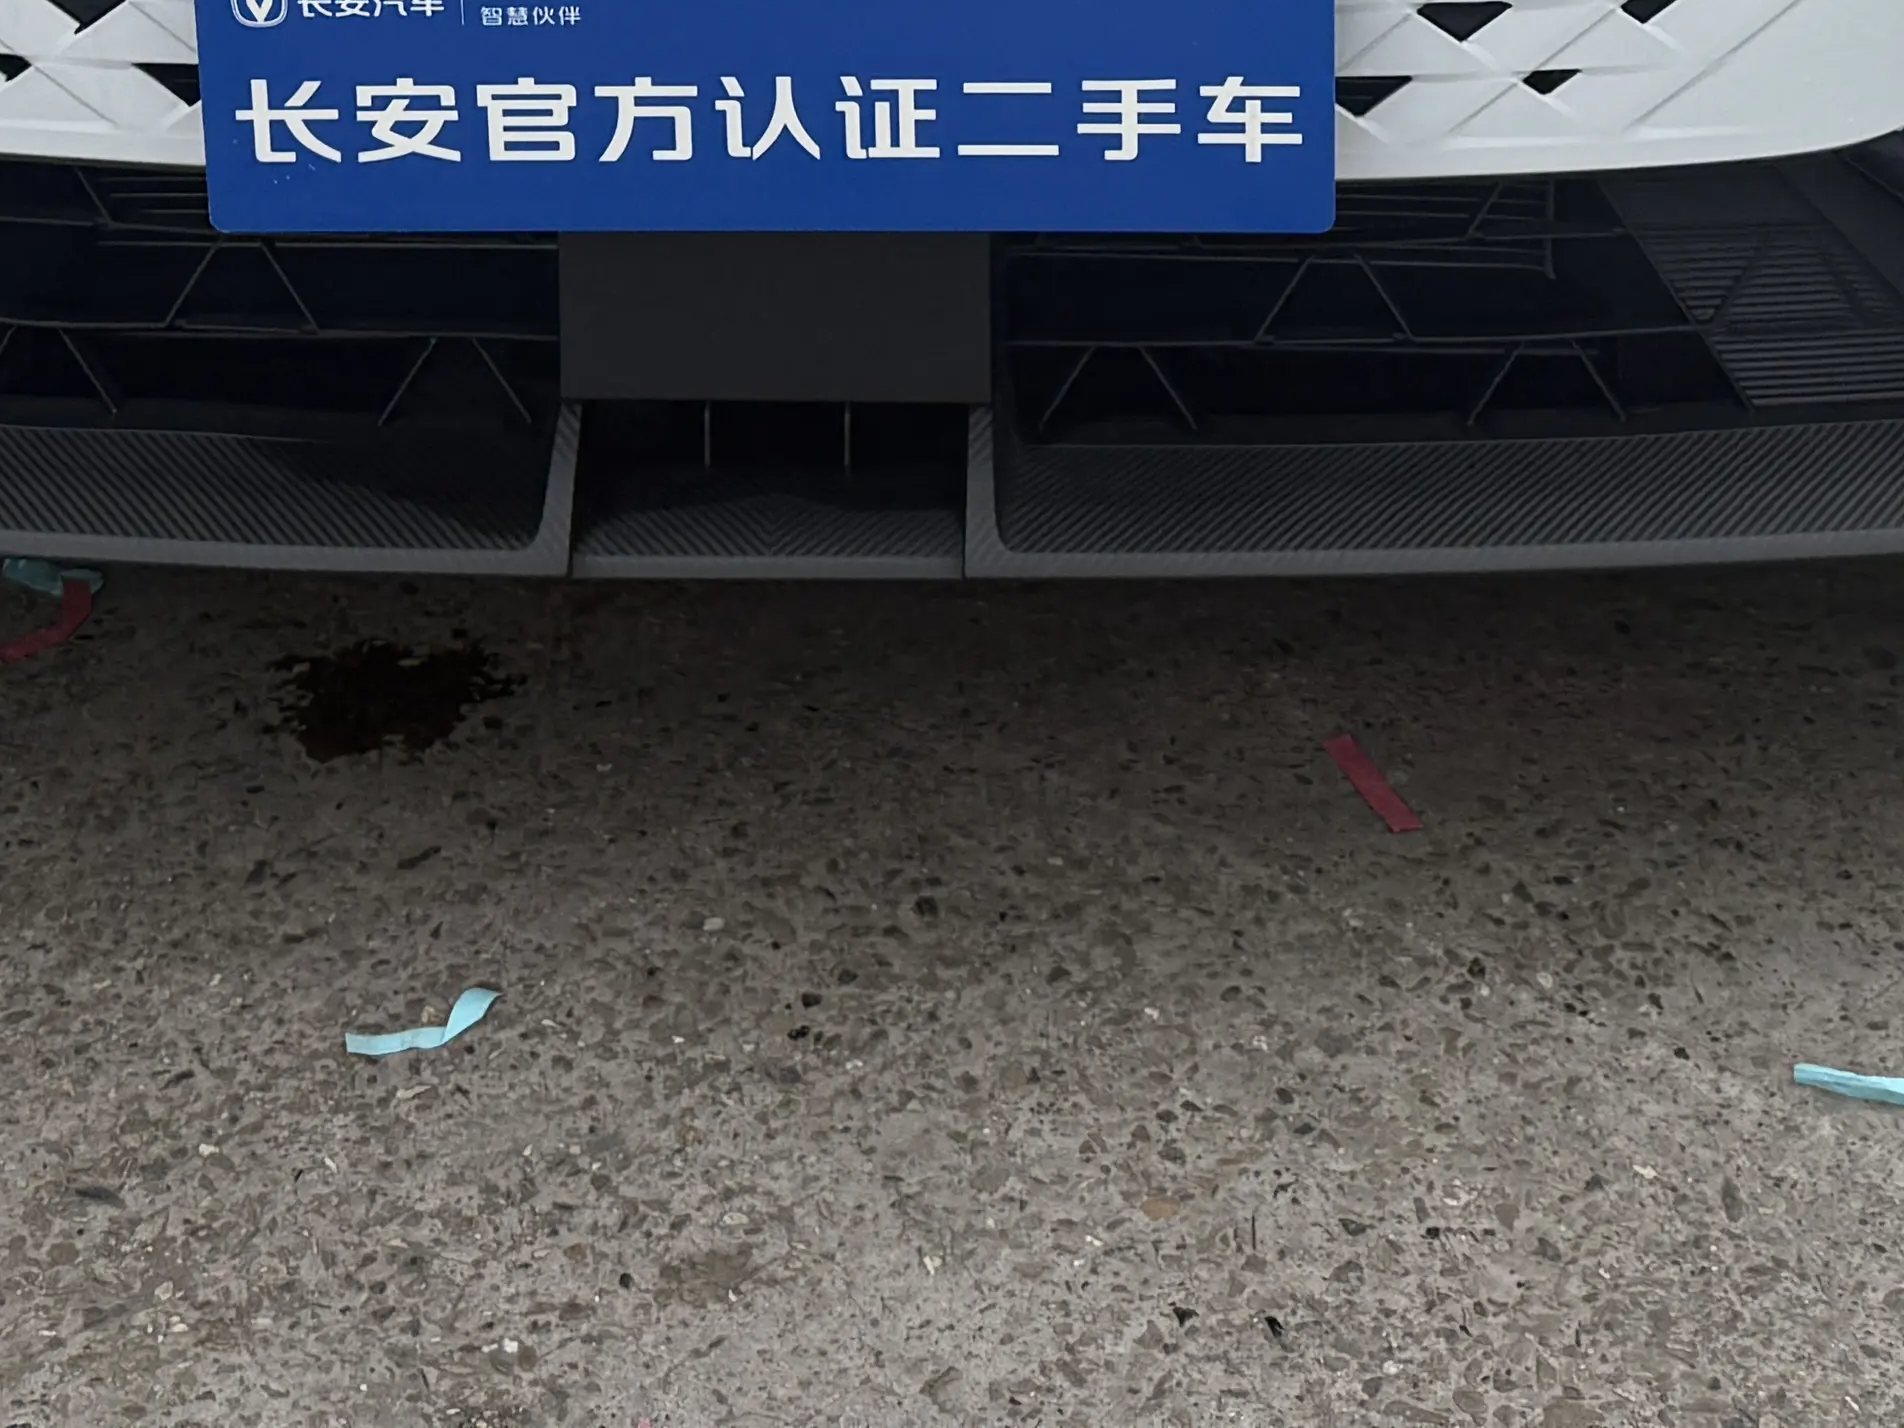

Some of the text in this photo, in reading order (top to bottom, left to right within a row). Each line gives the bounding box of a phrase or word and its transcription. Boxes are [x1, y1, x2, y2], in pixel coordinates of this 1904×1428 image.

[480, 5, 581, 26] 智慧伙伴
[234, 74, 1304, 164] 长安官方认证二手车
